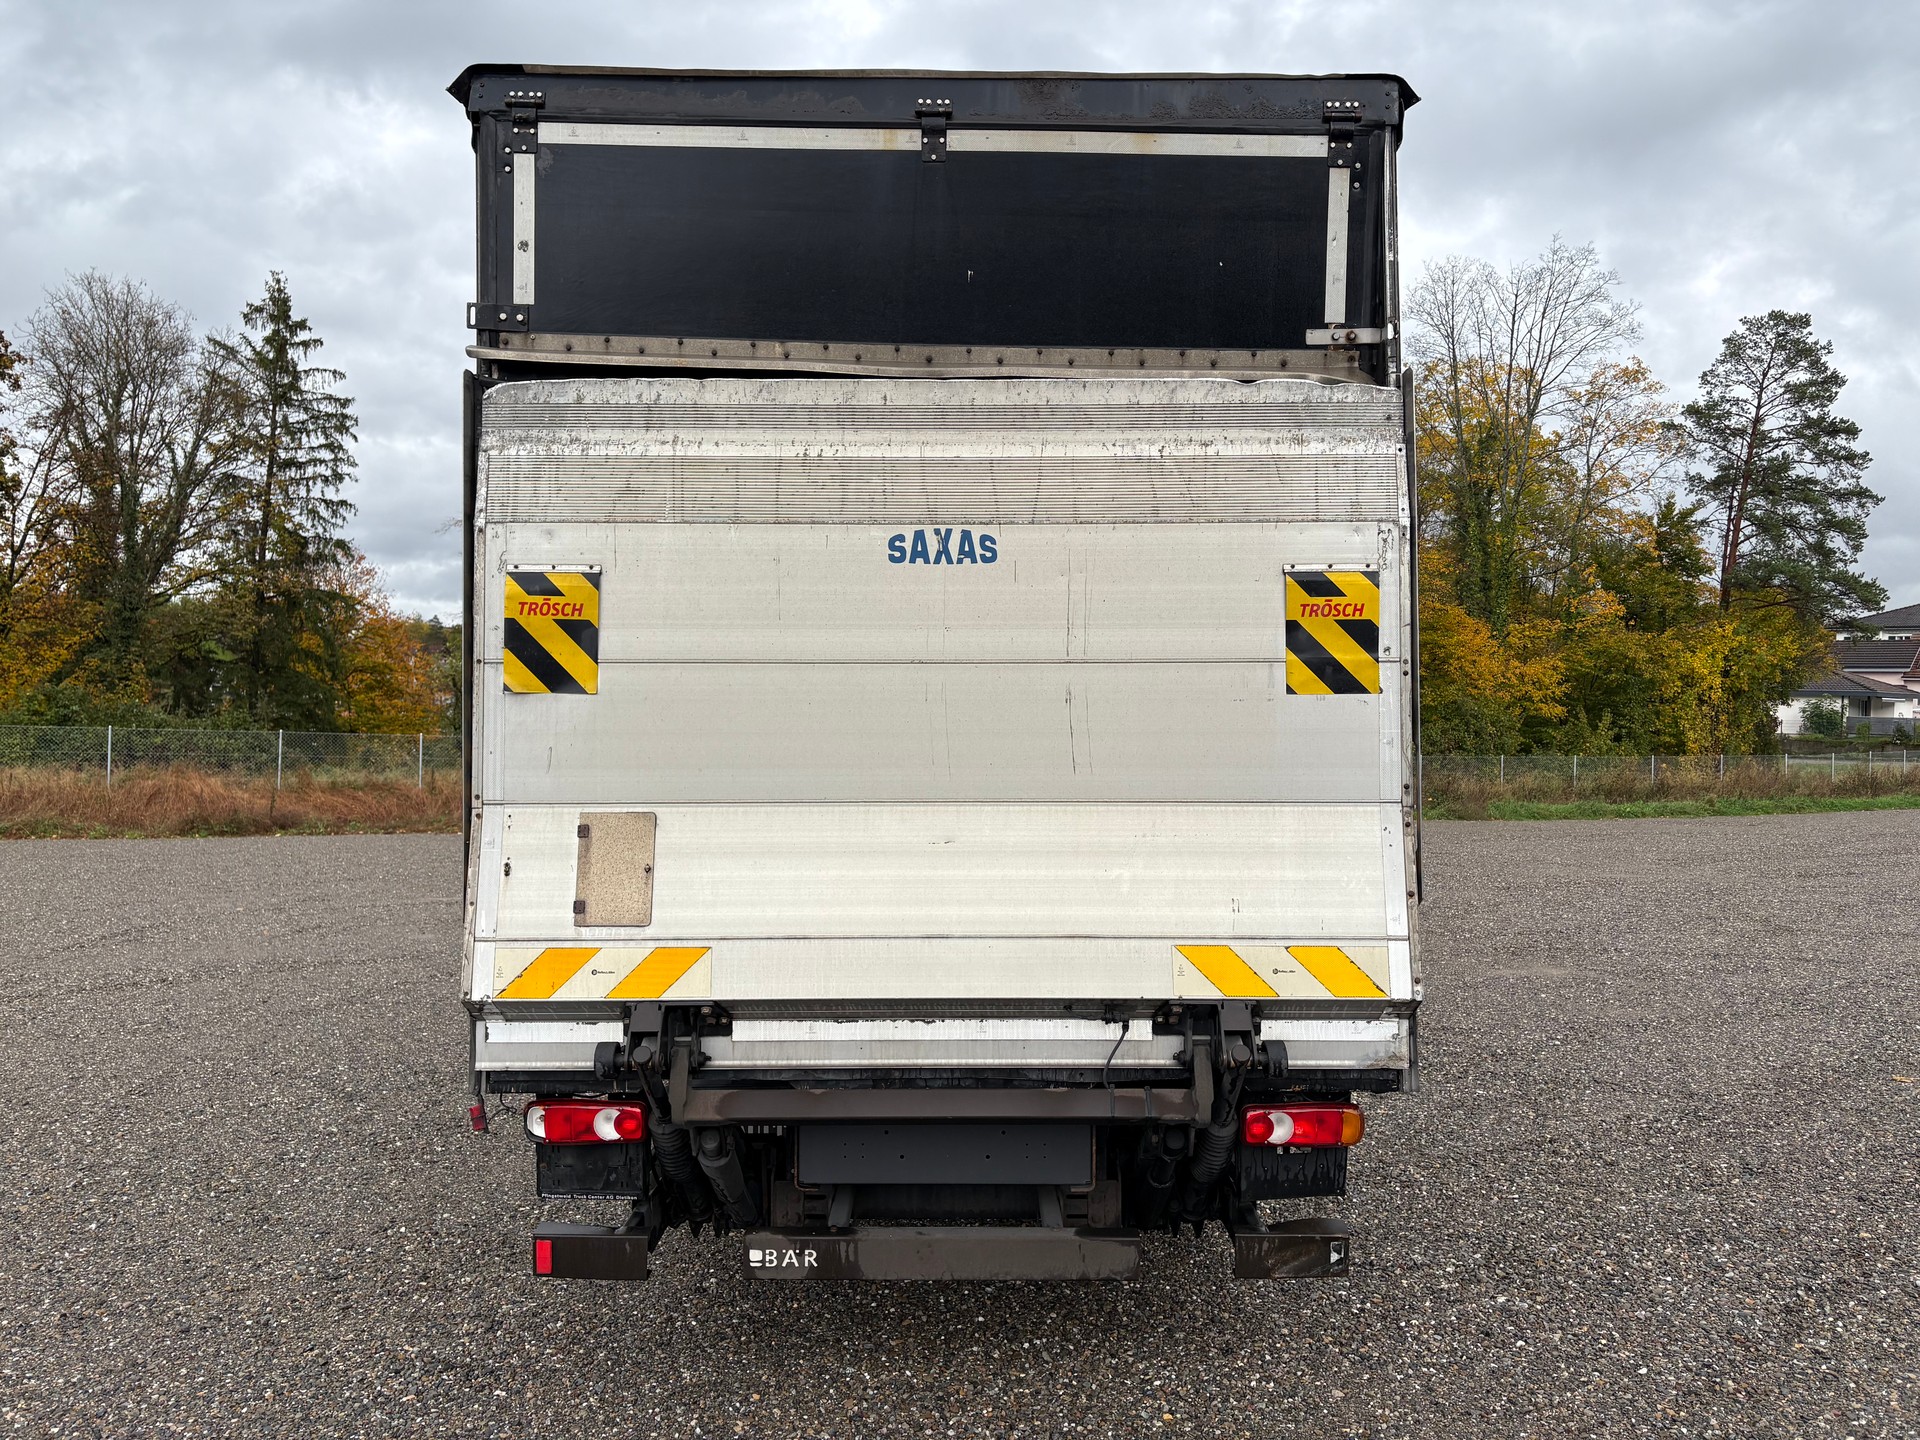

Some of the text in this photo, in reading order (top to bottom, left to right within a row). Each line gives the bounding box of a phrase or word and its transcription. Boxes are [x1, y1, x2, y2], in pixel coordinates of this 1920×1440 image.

[888, 528, 998, 565] SAXAS
[518, 598, 584, 617] TRÖSCH
[1300, 599, 1365, 618] TRÖSCH
[765, 1249, 818, 1267] BÄR
